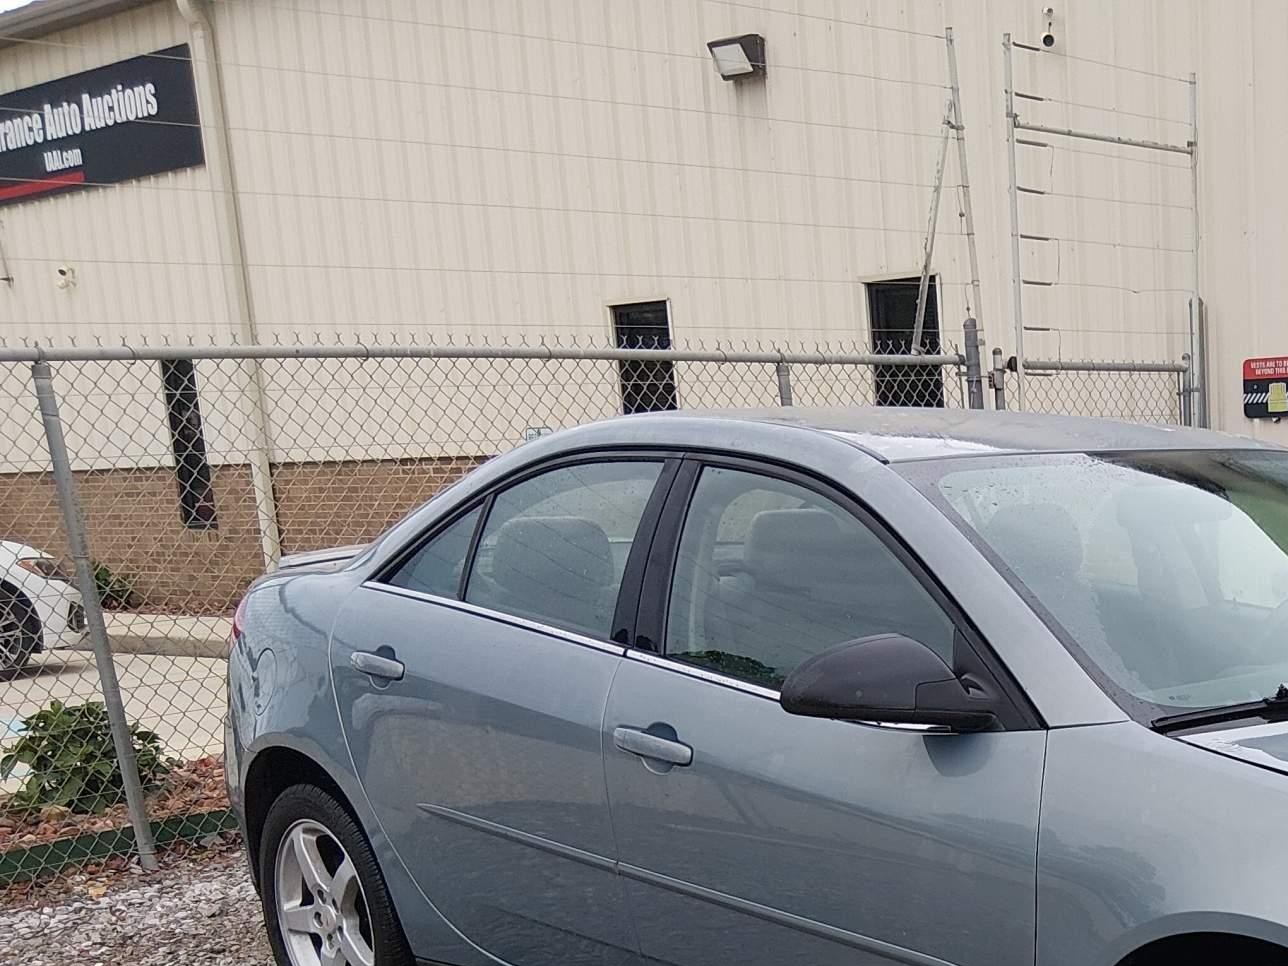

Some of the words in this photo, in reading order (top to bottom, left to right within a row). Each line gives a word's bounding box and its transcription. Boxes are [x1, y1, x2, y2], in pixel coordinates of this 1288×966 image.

[0, 113, 44, 153] rance
[43, 102, 82, 141] Auto
[82, 82, 157, 131] Auctions
[43, 148, 83, 172] IAAI.com
[1266, 360, 1275, 368] ARE
